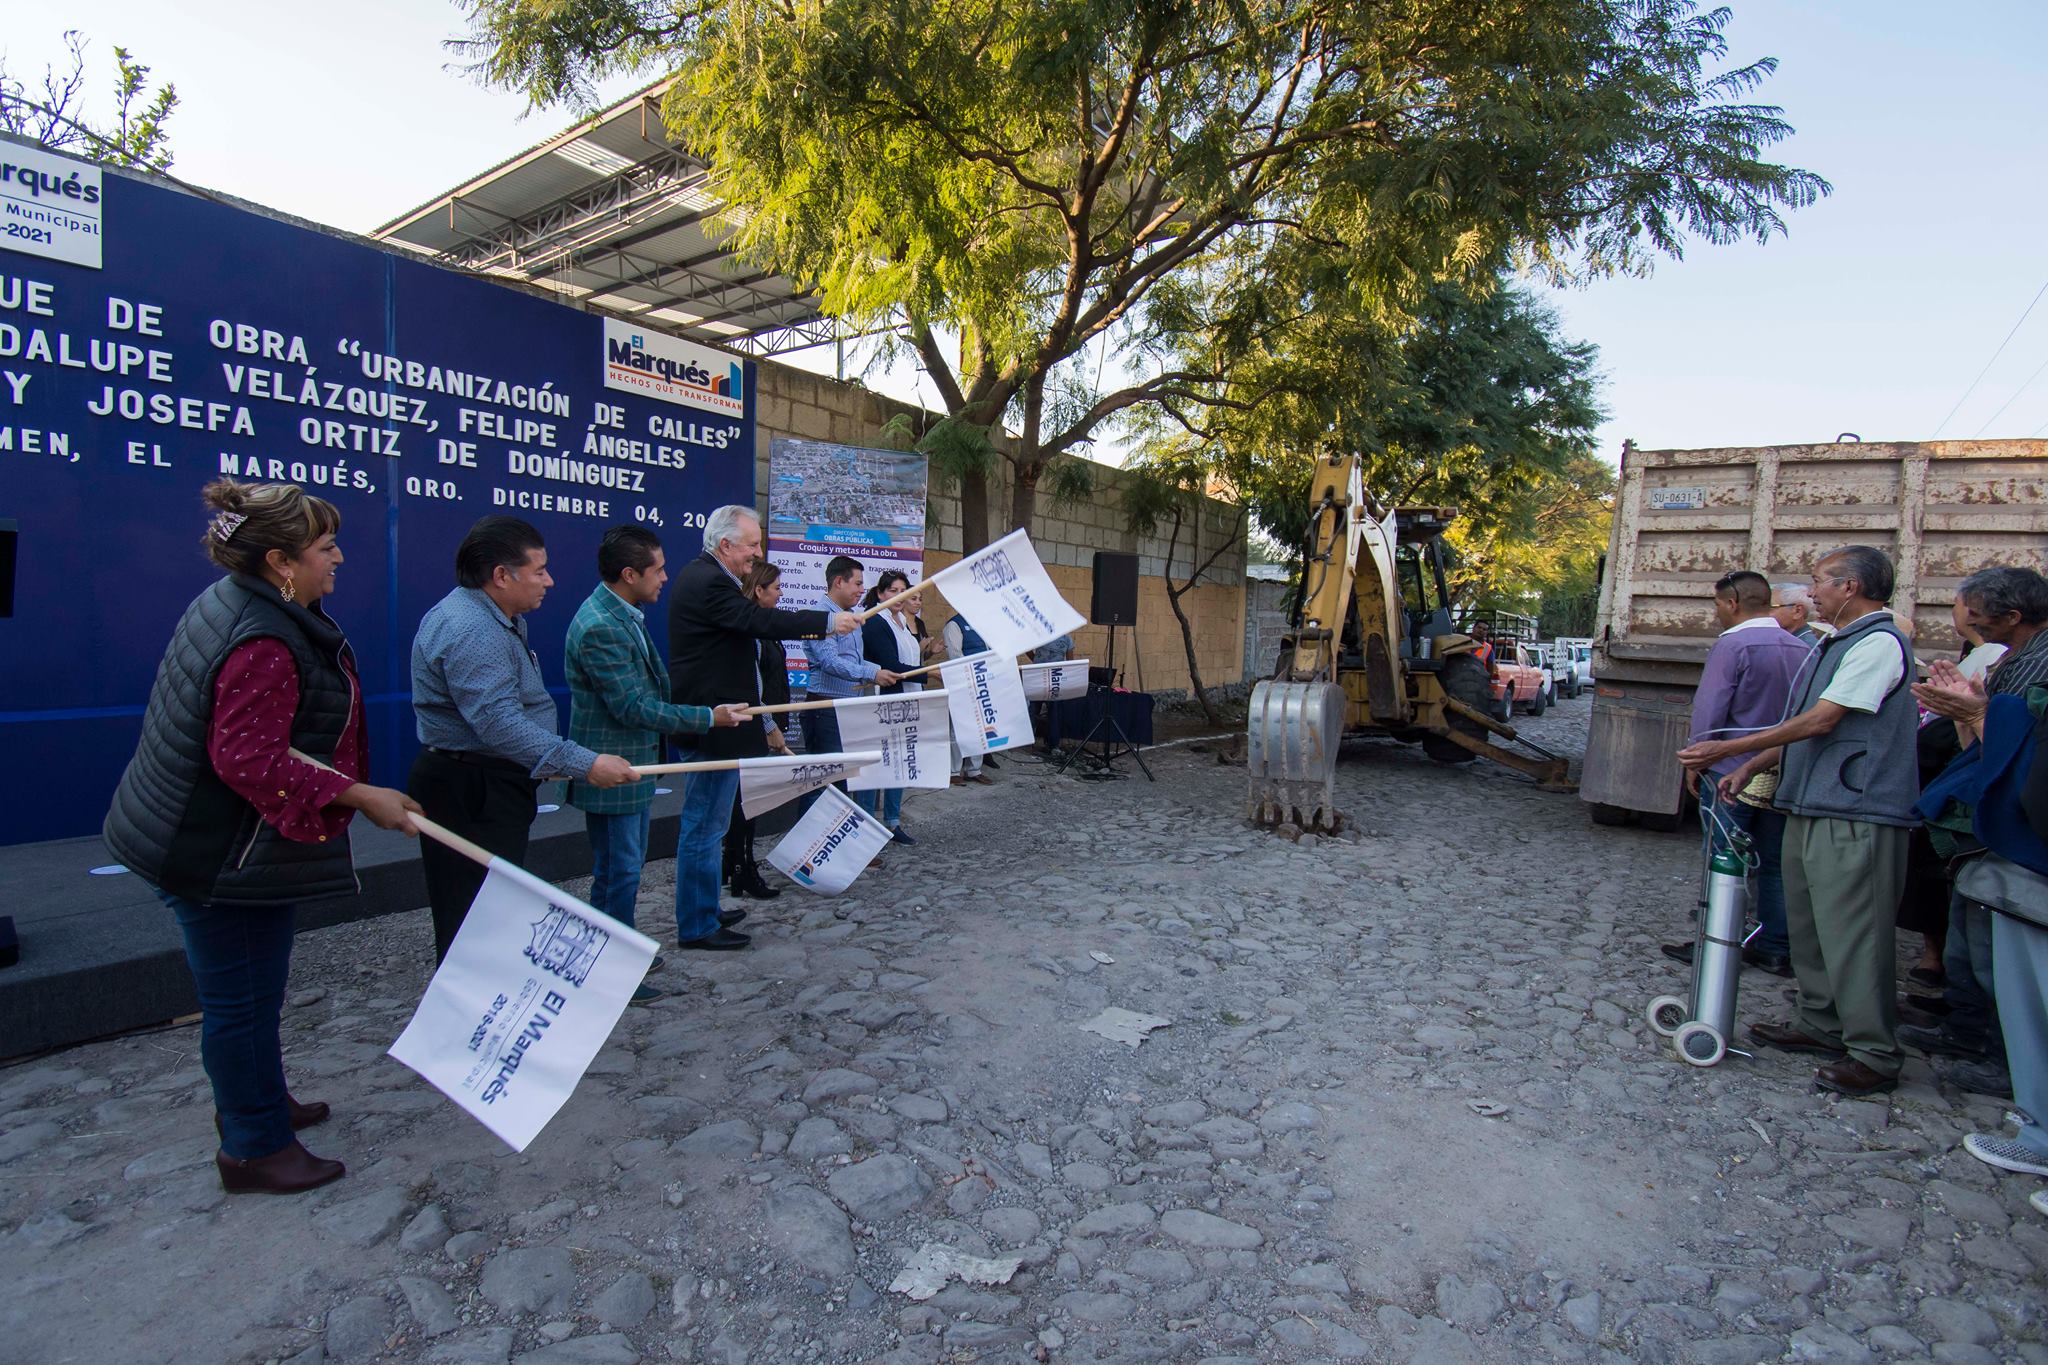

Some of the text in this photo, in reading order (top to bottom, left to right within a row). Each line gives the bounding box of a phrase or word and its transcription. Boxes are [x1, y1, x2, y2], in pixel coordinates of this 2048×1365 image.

[0, 163, 99, 204] rqués
[0, 222, 51, 244] -2021
[6, 203, 99, 235] Municipal
[0, 275, 741, 450] UE DE OBRA “URBANIZACIÓN DE CALLES”
[608, 338, 710, 387] Marqués
[631, 335, 644, 349] El
[0, 323, 686, 470] DALUPE VELÁZQUEZ, FELIPE ÁNGELES
[609, 371, 742, 411] HECHOS QUE TRANSFORMAN
[3, 370, 645, 493] Y JOSEFA ORTIZ DE DOMÍNGUEZ
[0, 426, 80, 463] MEN,
[127, 440, 172, 467] EL
[219, 452, 376, 494] MARQUÉS,
[406, 476, 463, 501] QRO.
[493, 487, 609, 518] DICIEMBRE
[634, 505, 664, 527] 04,
[798, 542, 898, 558] Croquis y metas de la obra
[824, 534, 874, 545] OBRAS PÚBLICAS
[973, 660, 997, 724] Marqués
[904, 726, 921, 780] El Marqués
[812, 811, 865, 867] Marqués
[481, 990, 567, 1105] El Marqués
